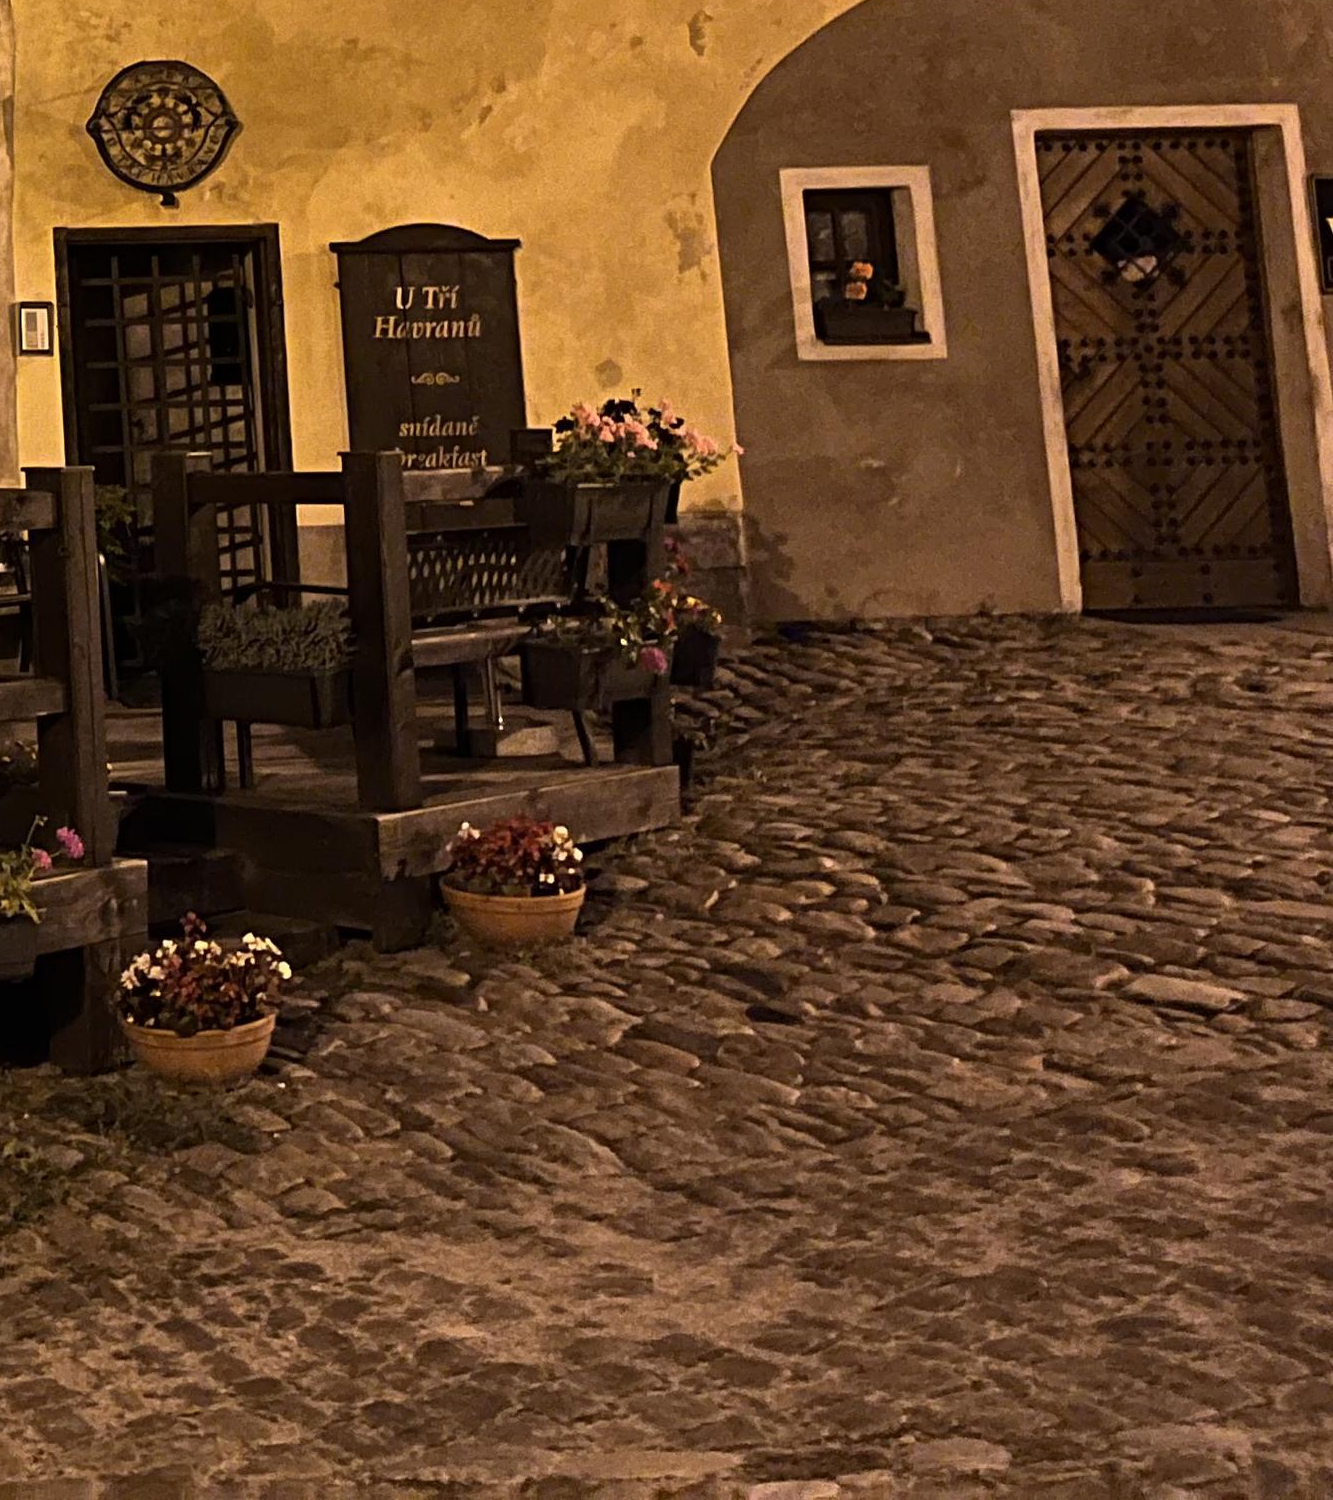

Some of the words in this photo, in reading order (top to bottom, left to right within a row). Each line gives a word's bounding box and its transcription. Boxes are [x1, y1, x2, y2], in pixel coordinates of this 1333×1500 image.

[395, 286, 415, 310] U
[422, 285, 460, 310] Tří
[373, 313, 482, 339] Havranů
[399, 414, 480, 437] snídaně
